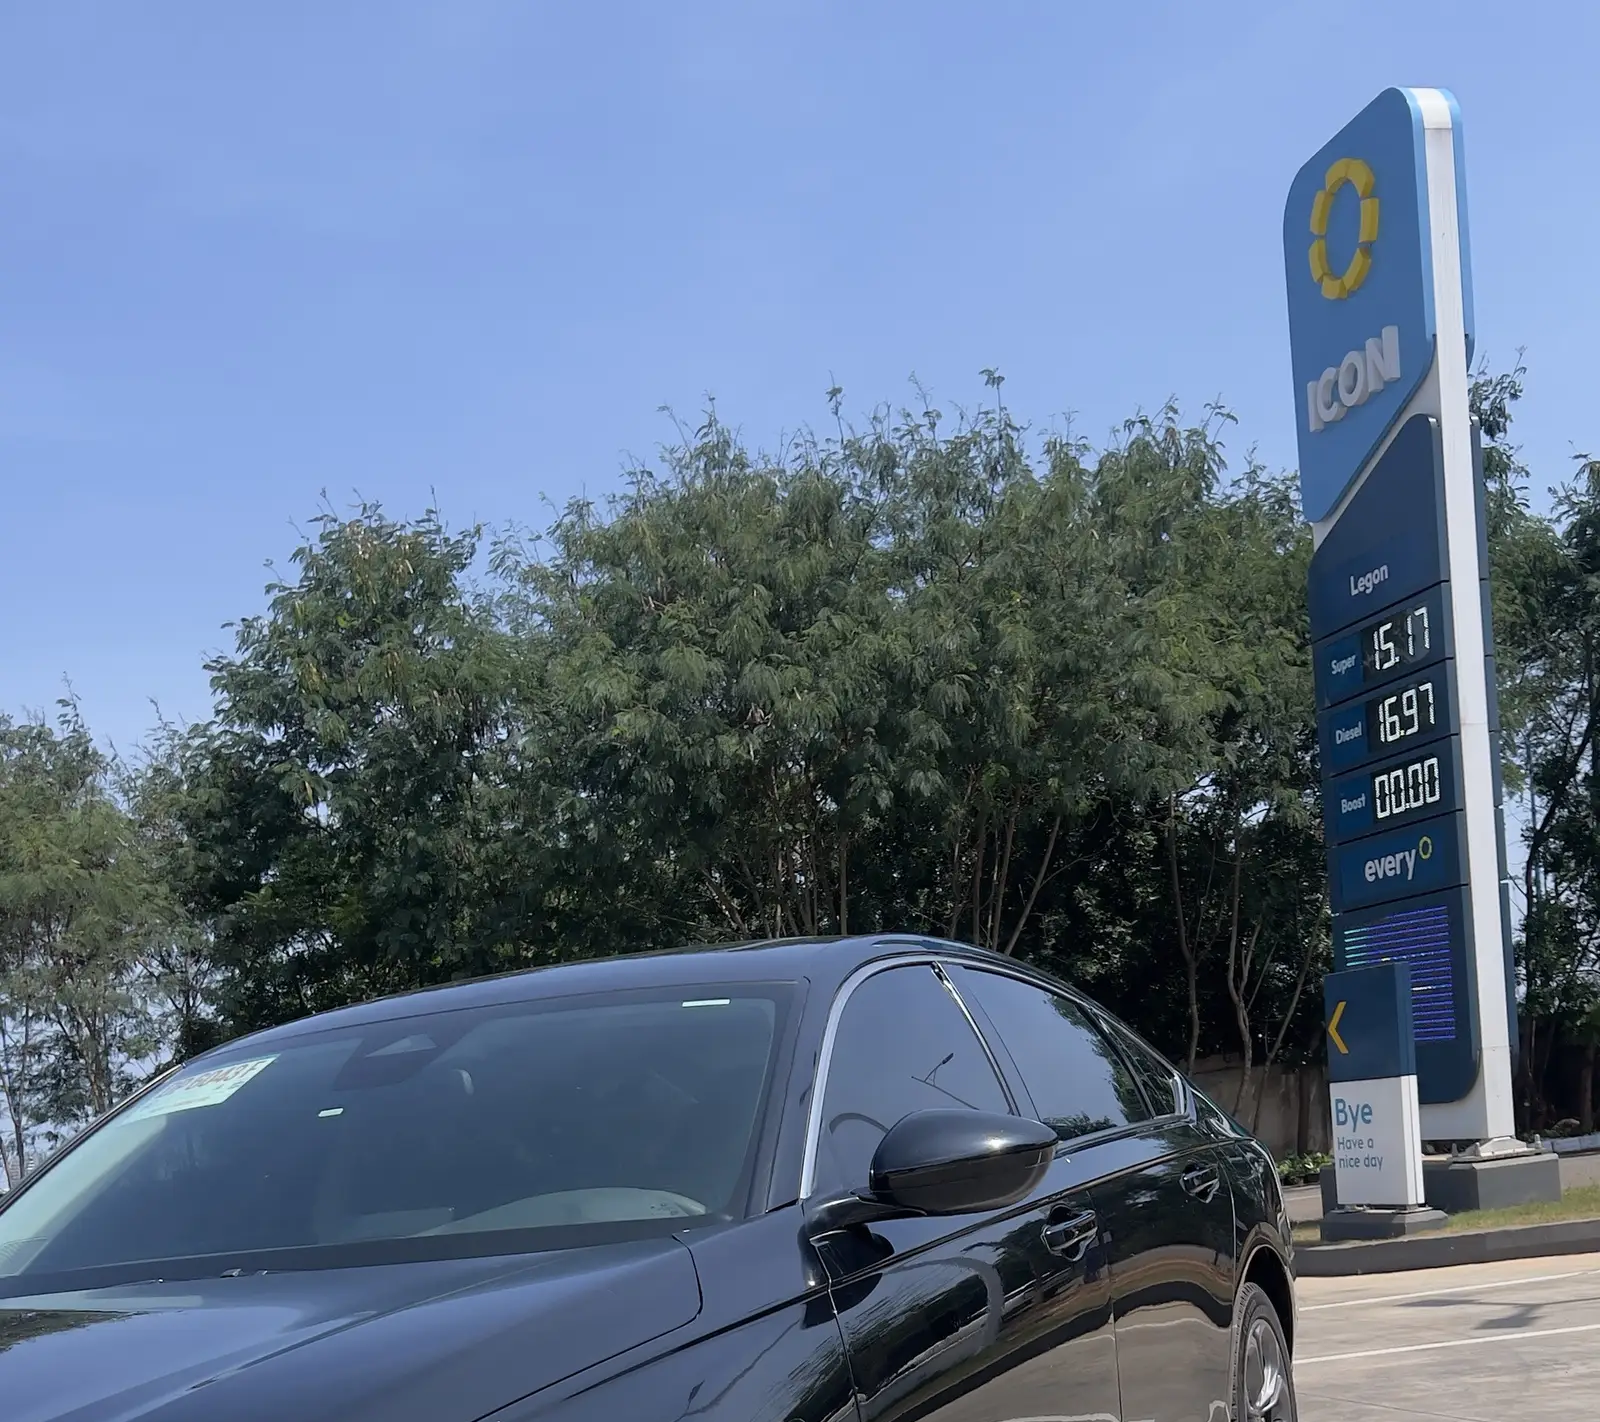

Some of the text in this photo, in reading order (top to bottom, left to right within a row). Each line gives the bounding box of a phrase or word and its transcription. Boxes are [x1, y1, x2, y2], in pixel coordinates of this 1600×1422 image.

[1307, 325, 1401, 433] ICON
[1350, 564, 1389, 596] Legon
[1331, 606, 1431, 675] Super 15.17
[1335, 682, 1436, 745] Diesel 16.97
[1341, 757, 1441, 819] Boost 00.00
[1335, 1098, 1373, 1132] Bye
[1337, 1136, 1374, 1150] Have a
[1339, 1153, 1384, 1172] nice day
